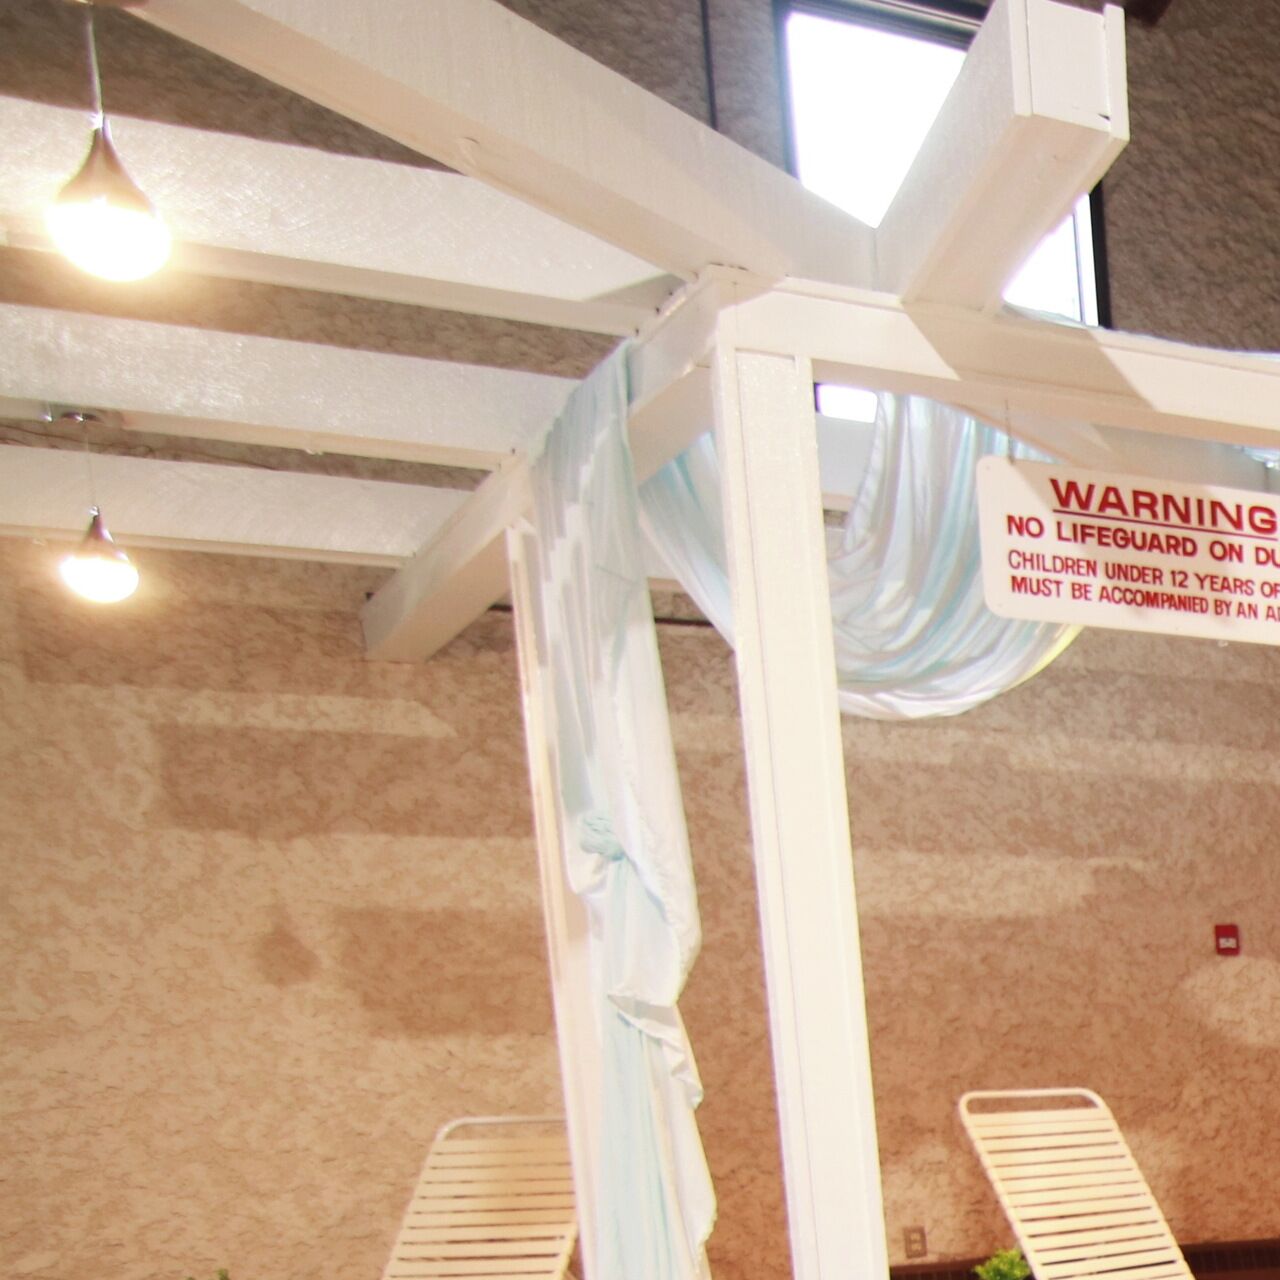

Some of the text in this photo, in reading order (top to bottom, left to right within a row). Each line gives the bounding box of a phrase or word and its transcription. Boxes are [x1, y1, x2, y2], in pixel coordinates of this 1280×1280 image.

[1050, 478, 1278, 535] WARNING
[1007, 515, 1044, 539] NO
[1057, 521, 1198, 557] LIFEGUARD
[1209, 539, 1243, 563] ON
[1008, 549, 1098, 578] CHILDREN
[1105, 562, 1164, 586] UNDER
[1170, 570, 1189, 589] 12
[1194, 572, 1255, 597] YEARS
[1011, 576, 1063, 599] MUST
[1071, 582, 1093, 601] BE
[1099, 586, 1209, 614] ACCOMPANIED
[1214, 599, 1233, 617] BY
[1236, 602, 1258, 620] AN
